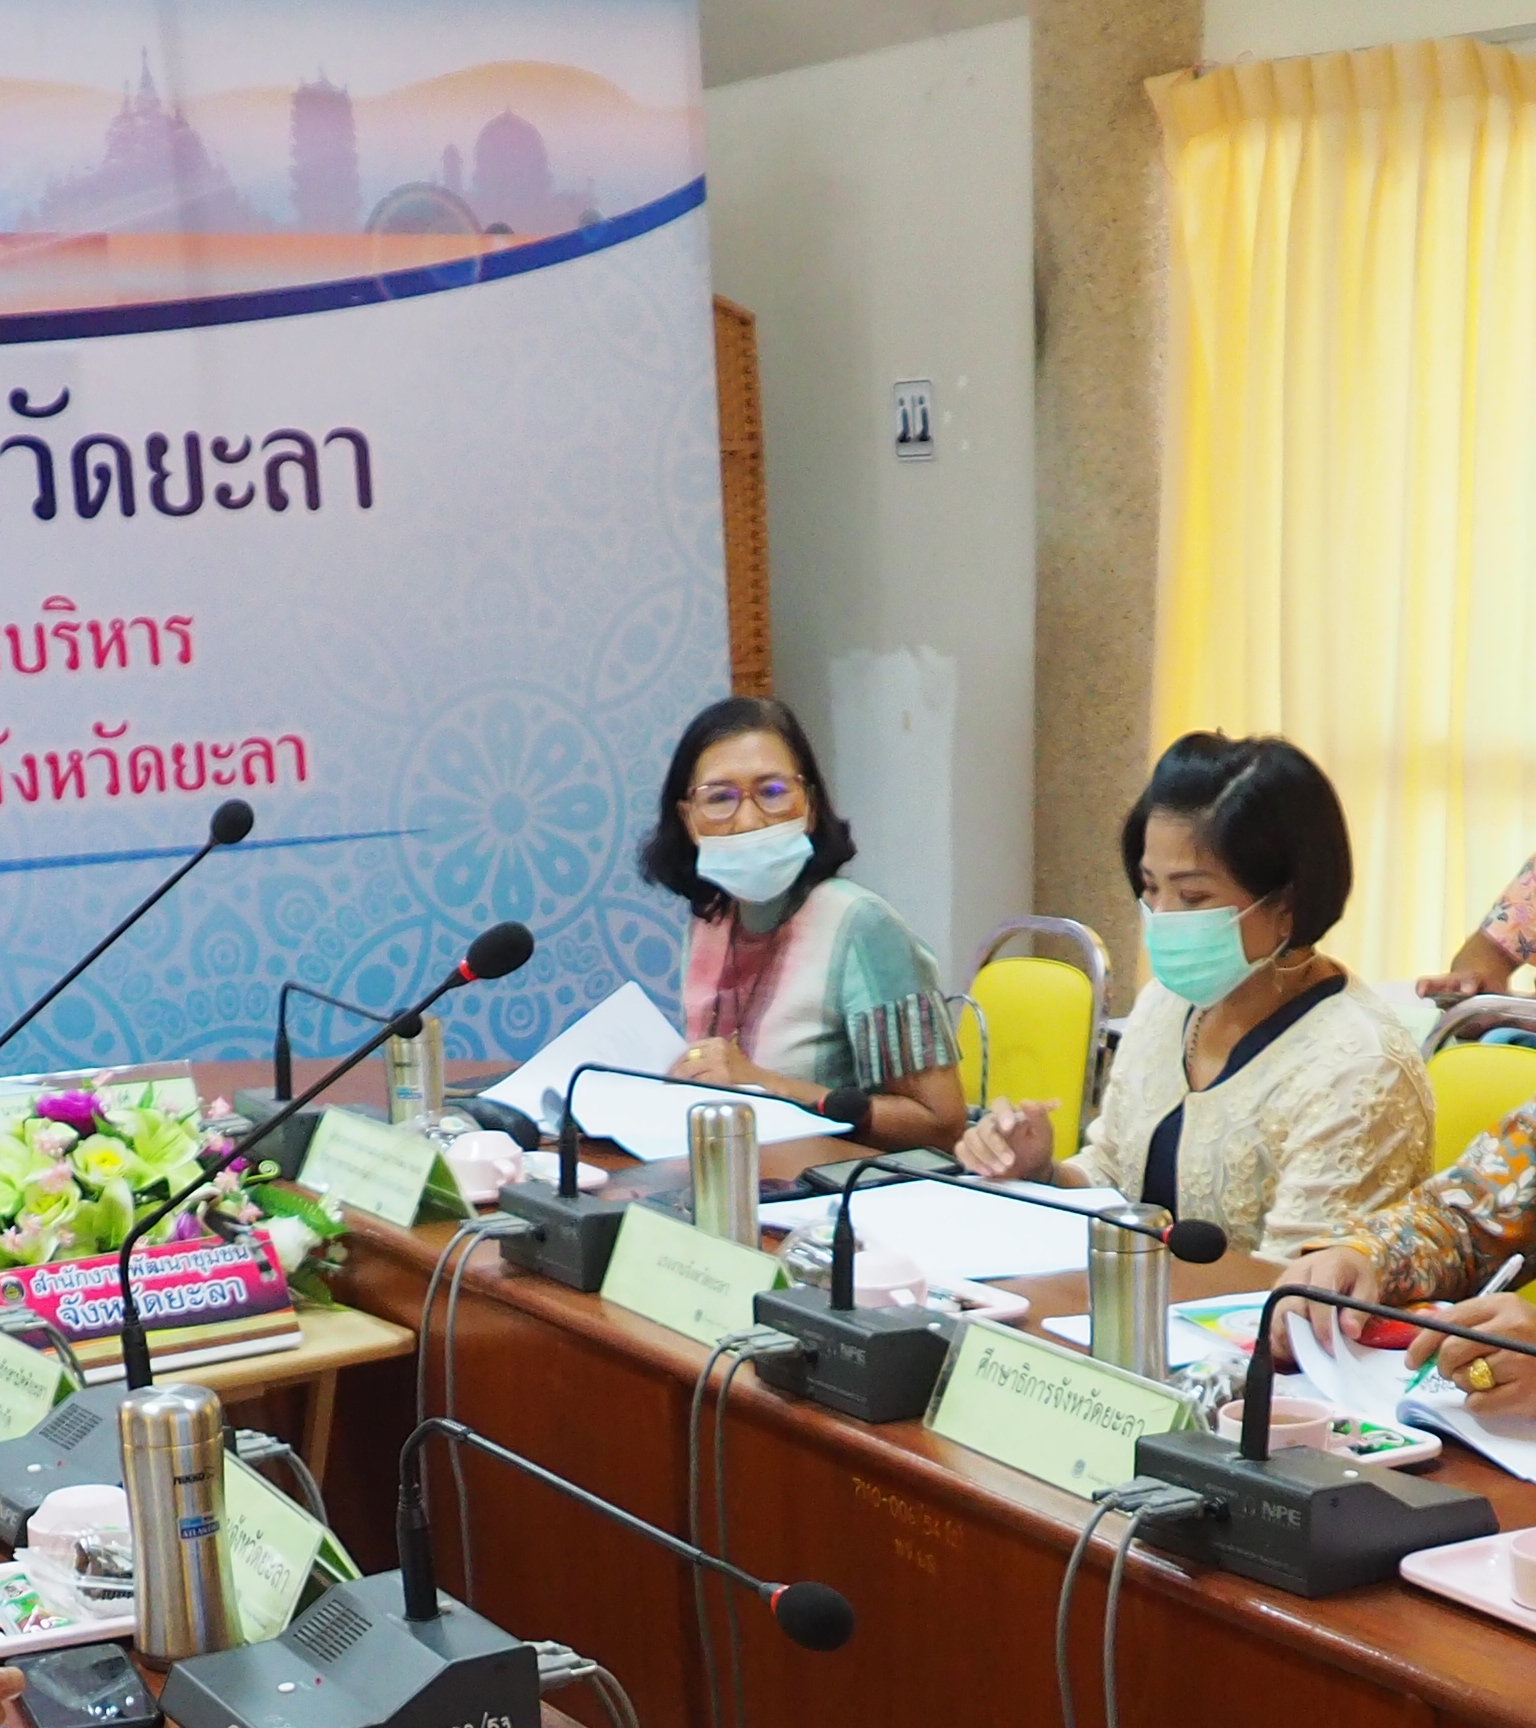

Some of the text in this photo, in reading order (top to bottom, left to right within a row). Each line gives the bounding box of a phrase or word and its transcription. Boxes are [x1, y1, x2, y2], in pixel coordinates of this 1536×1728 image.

[33, 1245, 250, 1293] สำนักงาพัฒนาชุมชน
[975, 1347, 1146, 1438] ศึกษาธิการจังหวัดยะลา
[1261, 1500, 1302, 1527] NPE
